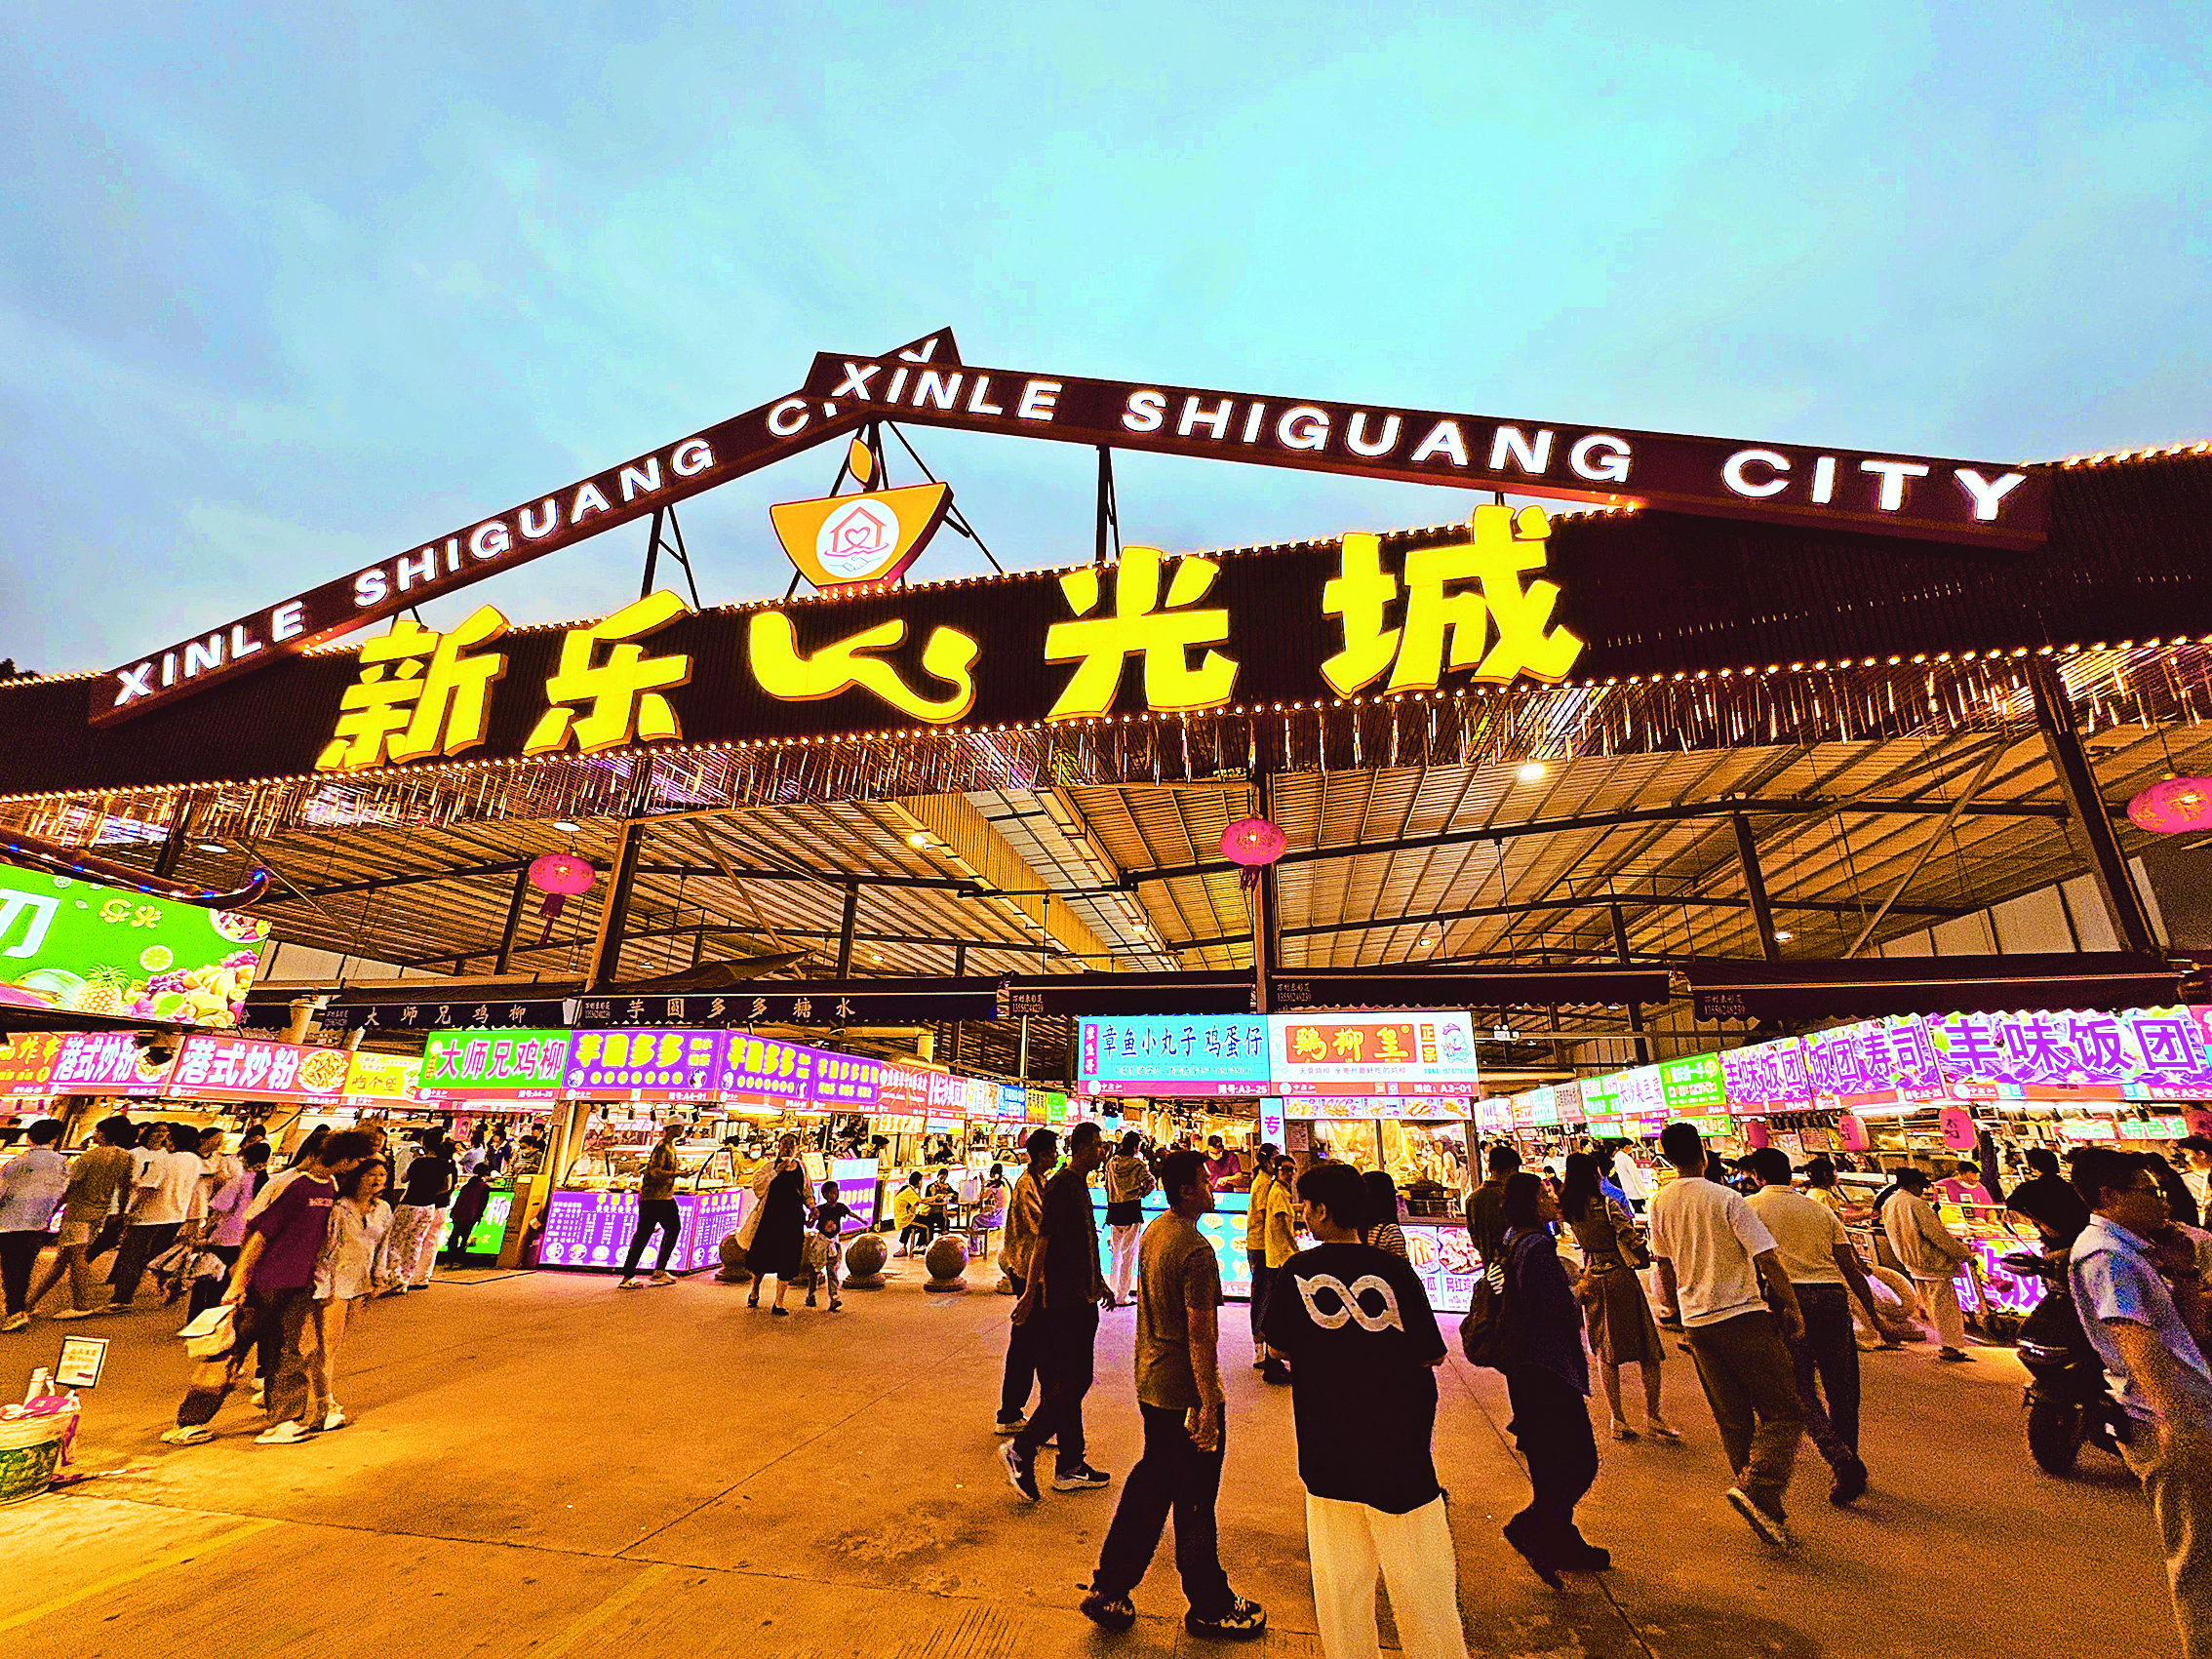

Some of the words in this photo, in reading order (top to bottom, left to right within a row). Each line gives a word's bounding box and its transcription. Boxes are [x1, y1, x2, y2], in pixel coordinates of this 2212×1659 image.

[831, 362, 1064, 421] XINLE
[1122, 391, 1632, 483] SHIGUANG
[1722, 449, 2028, 522] CITY
[114, 600, 305, 707] XINLE
[354, 438, 716, 608] SHIGUANG
[366, 1004, 528, 1027] 大师兄鸡柳
[53, 1035, 138, 1082] 港式炒粉
[174, 1038, 299, 1090] 港式炒粉
[434, 1037, 569, 1082] 大师兄鸡柳
[1101, 1023, 1198, 1059] 章鱼小丸子
[1203, 1023, 1265, 1059] 鸡蛋仔
[1420, 1024, 1438, 1063] 正宗
[1806, 1024, 1930, 1088] 饭团寿司
[1941, 1016, 2202, 1074] 丰味饭团
[1440, 1084, 1473, 1094] A3-01
[1722, 1047, 1806, 1103] 丰味饭团
